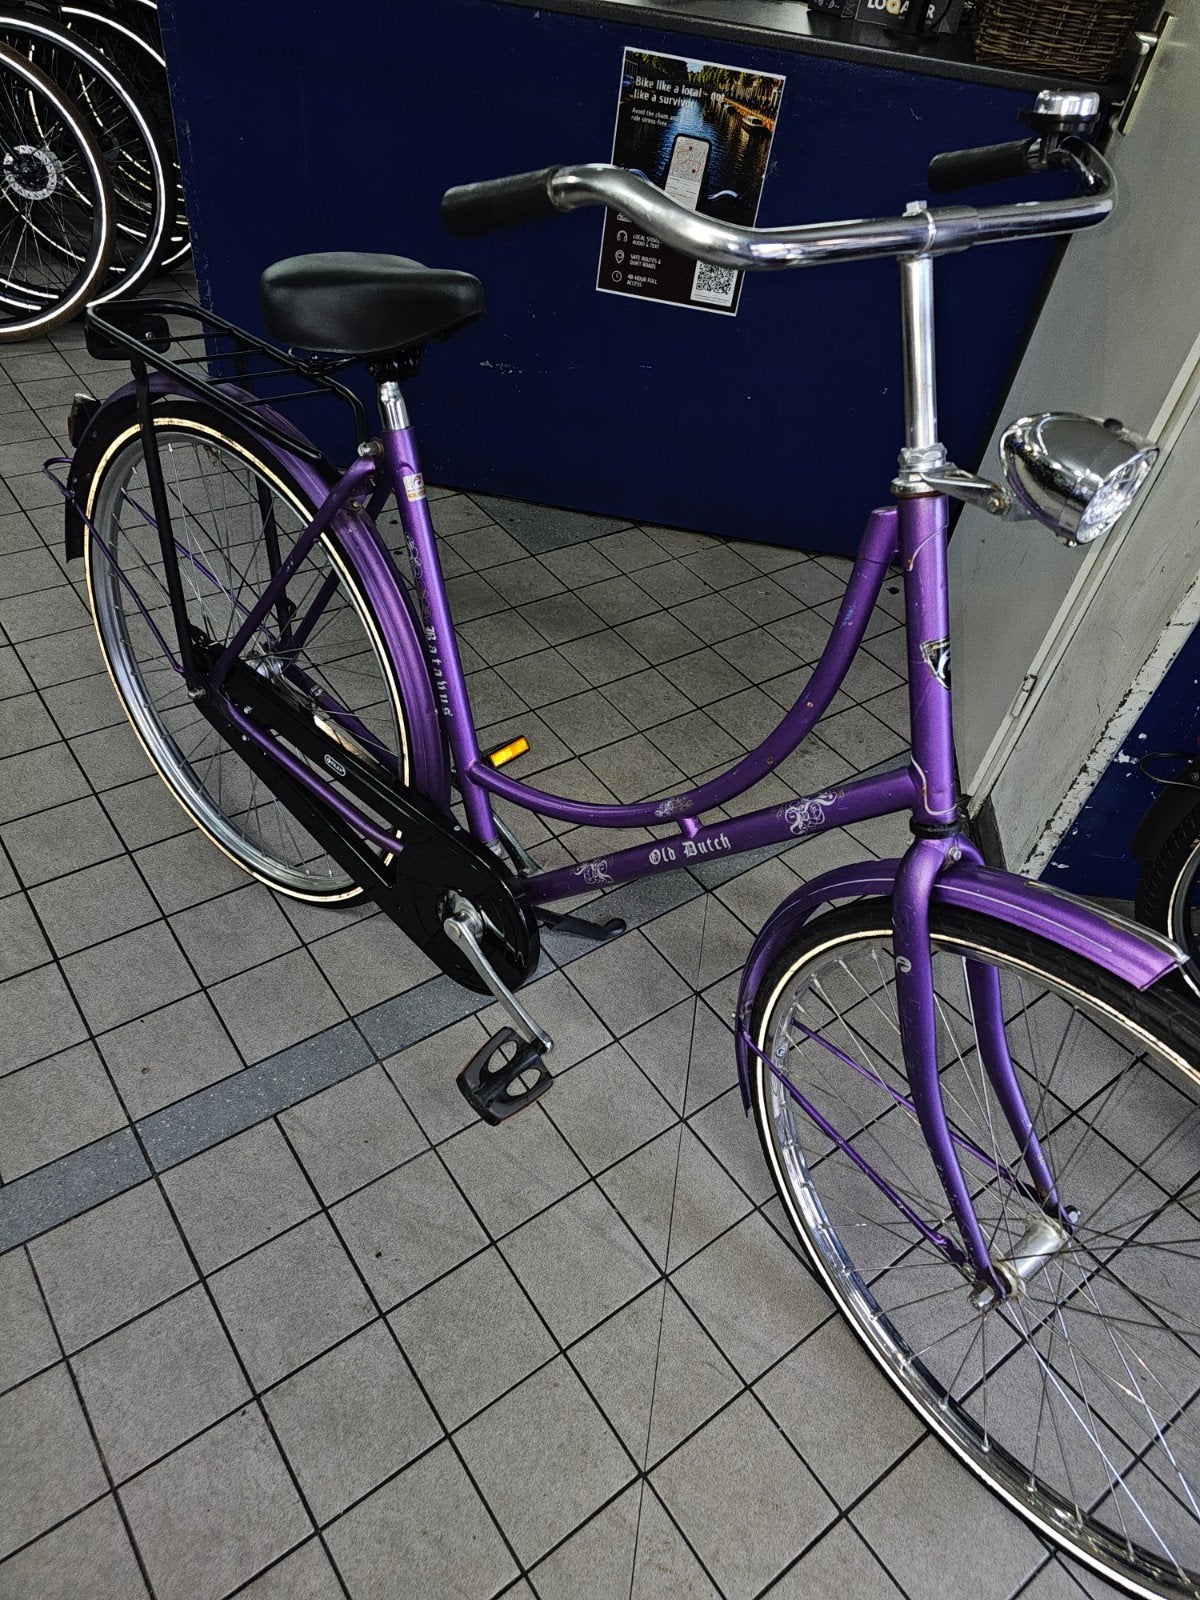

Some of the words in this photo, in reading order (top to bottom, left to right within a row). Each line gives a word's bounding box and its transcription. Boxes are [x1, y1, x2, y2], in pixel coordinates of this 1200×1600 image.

[633, 88, 649, 101] like
[651, 93, 657, 102] a
[659, 95, 695, 108] survivor
[635, 76, 654, 88] Bike
[656, 79, 672, 92] like
[673, 85, 679, 94] a
[681, 84, 702, 97] local
[710, 92, 725, 103] not
[632, 107, 646, 115] Avoid
[646, 109, 655, 117] the
[630, 253, 641, 261] SAFE
[647, 277, 658, 285] FULL
[425, 625, 453, 716] Batavus
[649, 846, 677, 865] Old
[682, 832, 732, 858] Dutch
